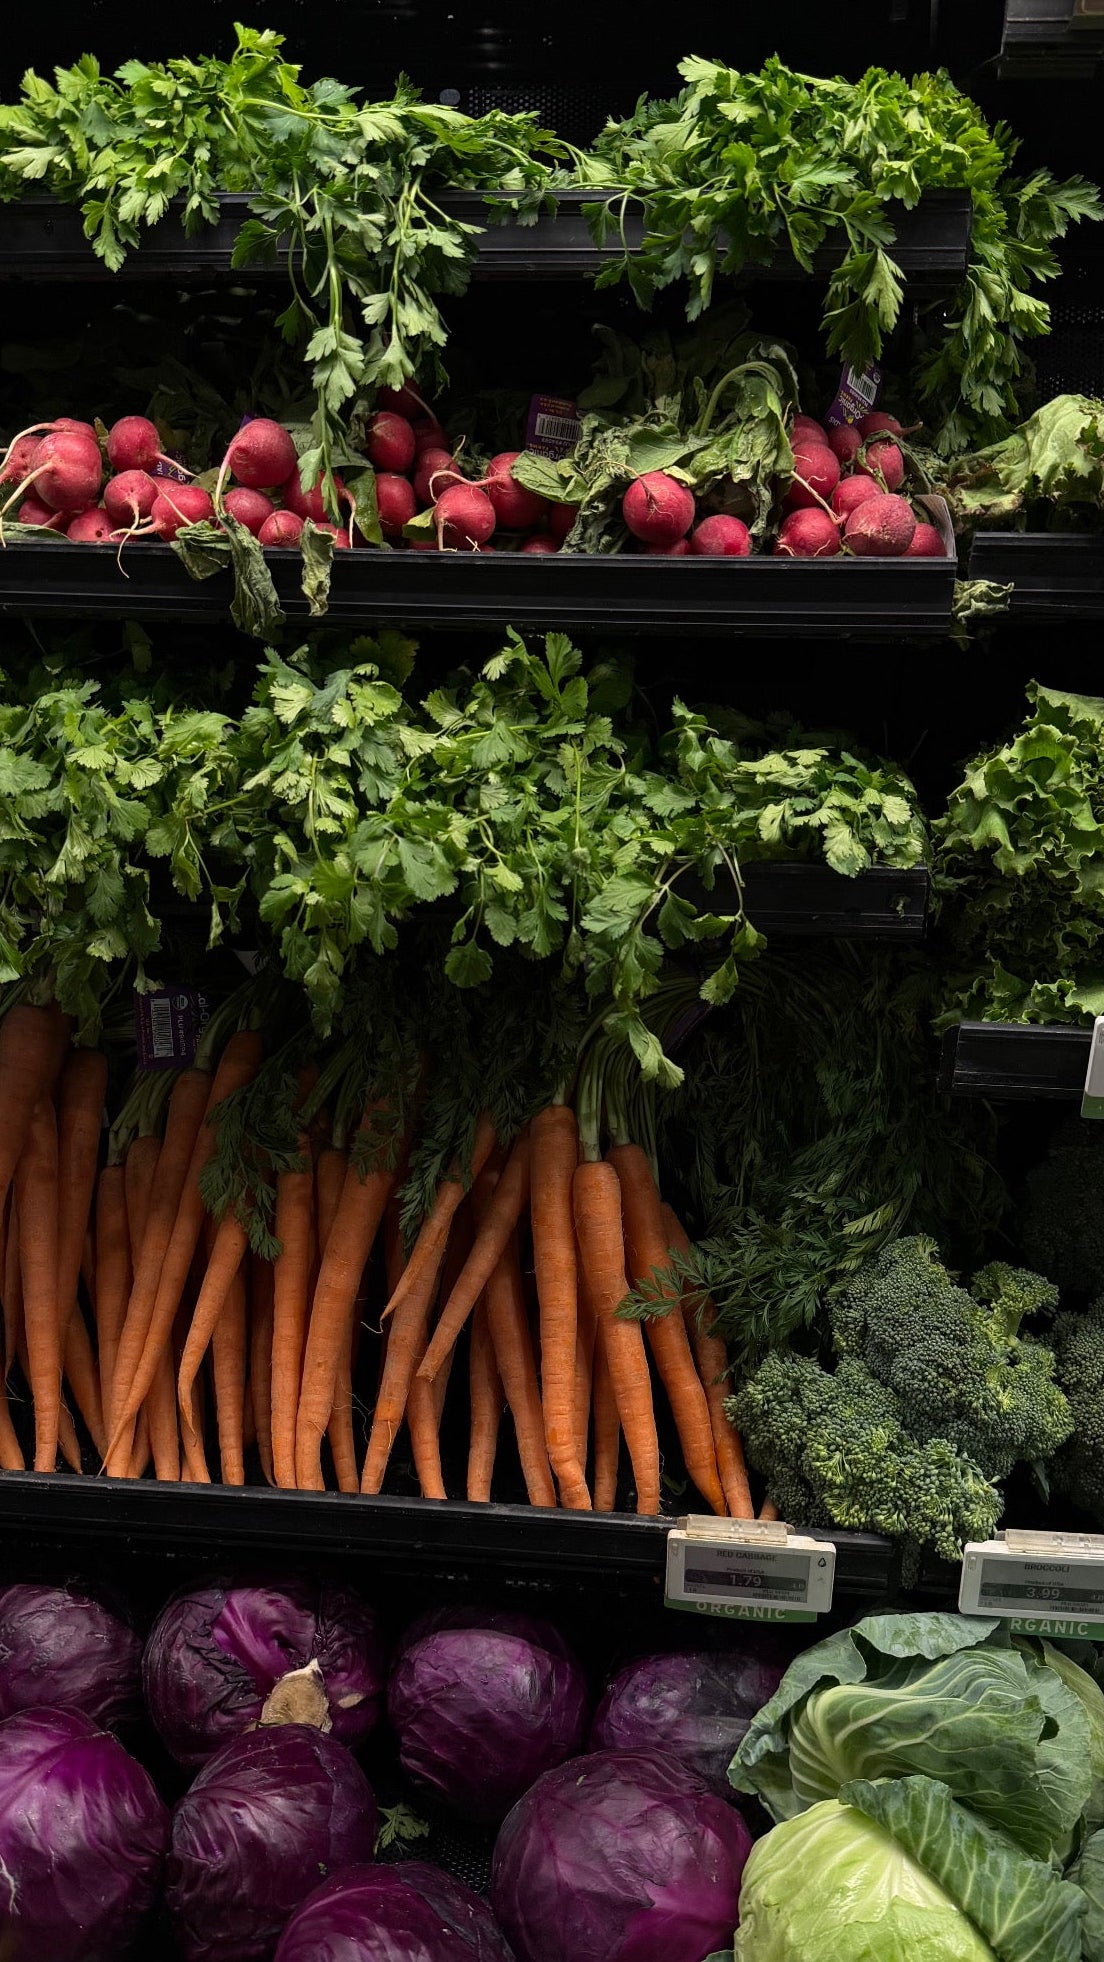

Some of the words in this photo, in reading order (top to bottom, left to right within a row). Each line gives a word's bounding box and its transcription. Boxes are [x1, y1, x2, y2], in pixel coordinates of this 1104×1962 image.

[716, 1550, 733, 1559] RED
[735, 1551, 777, 1562] CABBAGE
[1024, 1563, 1070, 1573] BROCCOLI
[729, 1574, 762, 1587] 1.79
[1026, 1587, 1061, 1599] 3.99
[696, 1602, 786, 1620] ORGANIC
[1010, 1618, 1089, 1636] RGANIC
